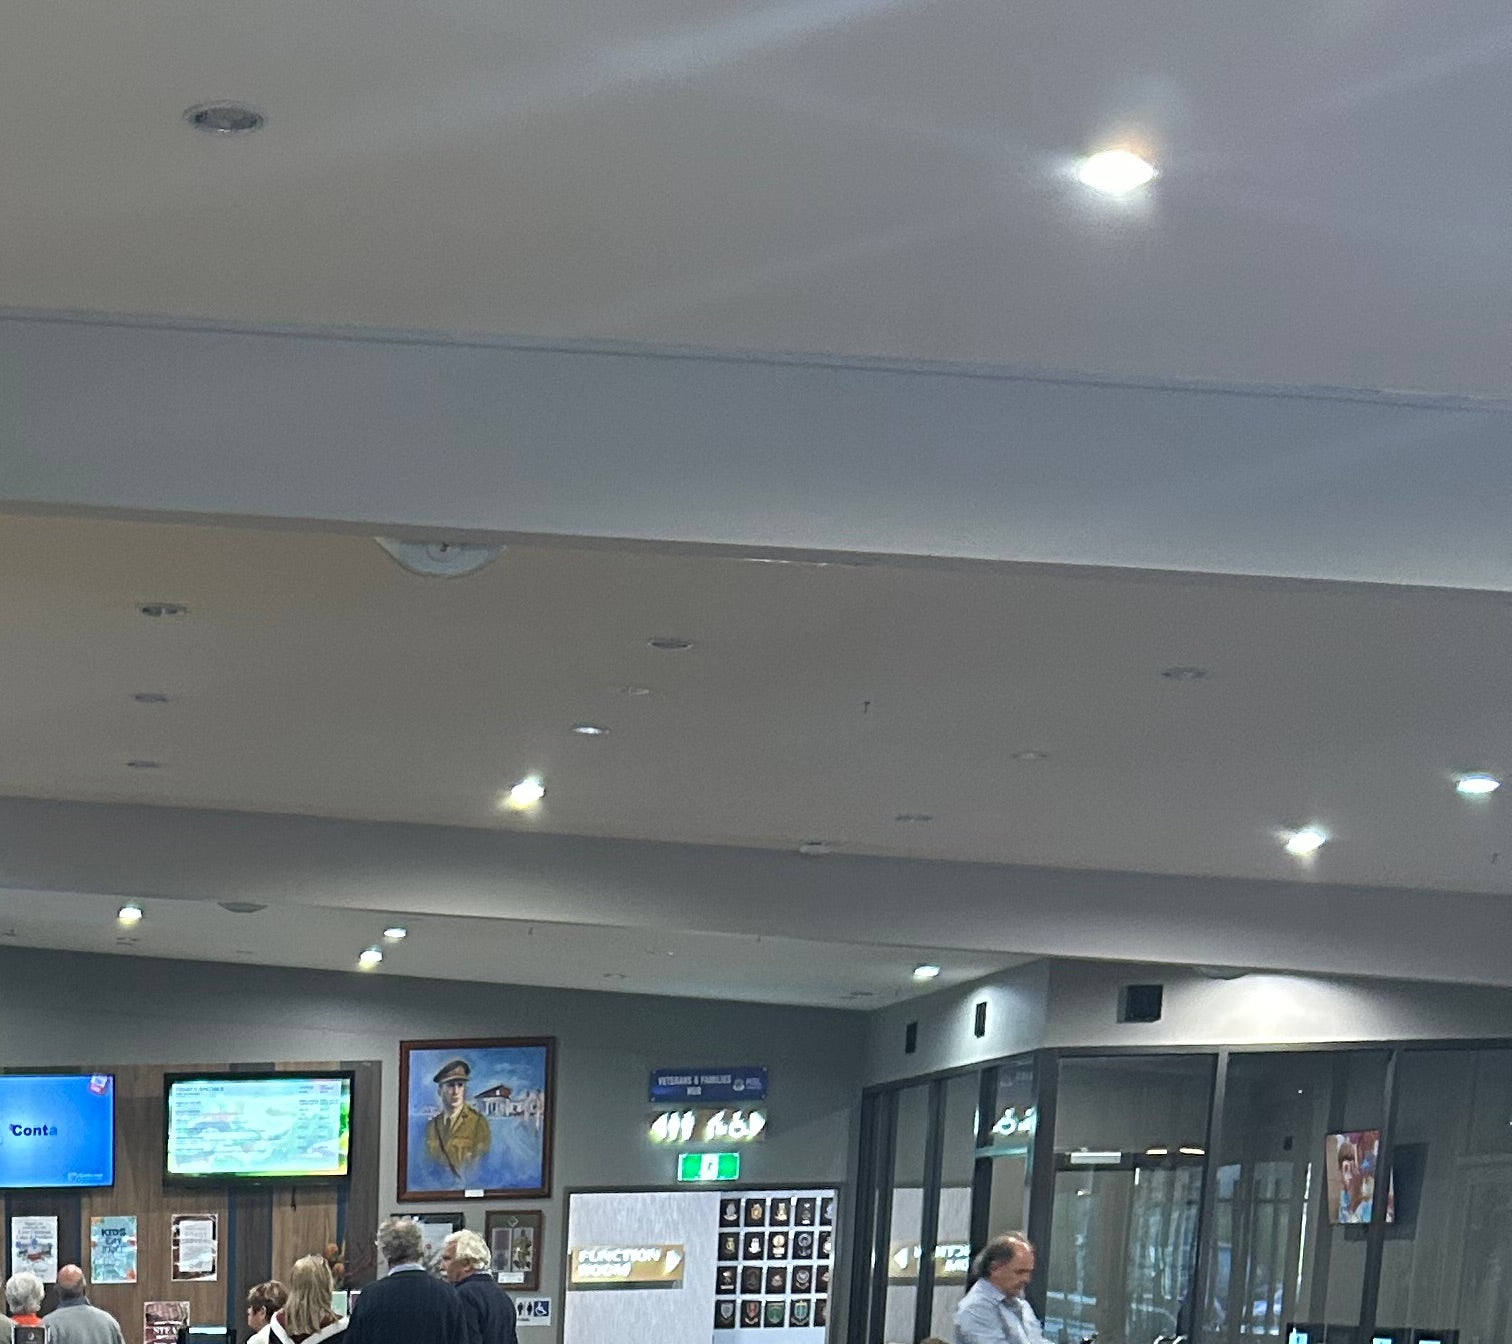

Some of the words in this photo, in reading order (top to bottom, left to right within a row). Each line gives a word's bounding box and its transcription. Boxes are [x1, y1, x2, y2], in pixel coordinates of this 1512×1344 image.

[657, 1076, 692, 1086] VETERANS
[700, 1074, 732, 1084] FAMILIES
[101, 1228, 127, 1237] KIDS
